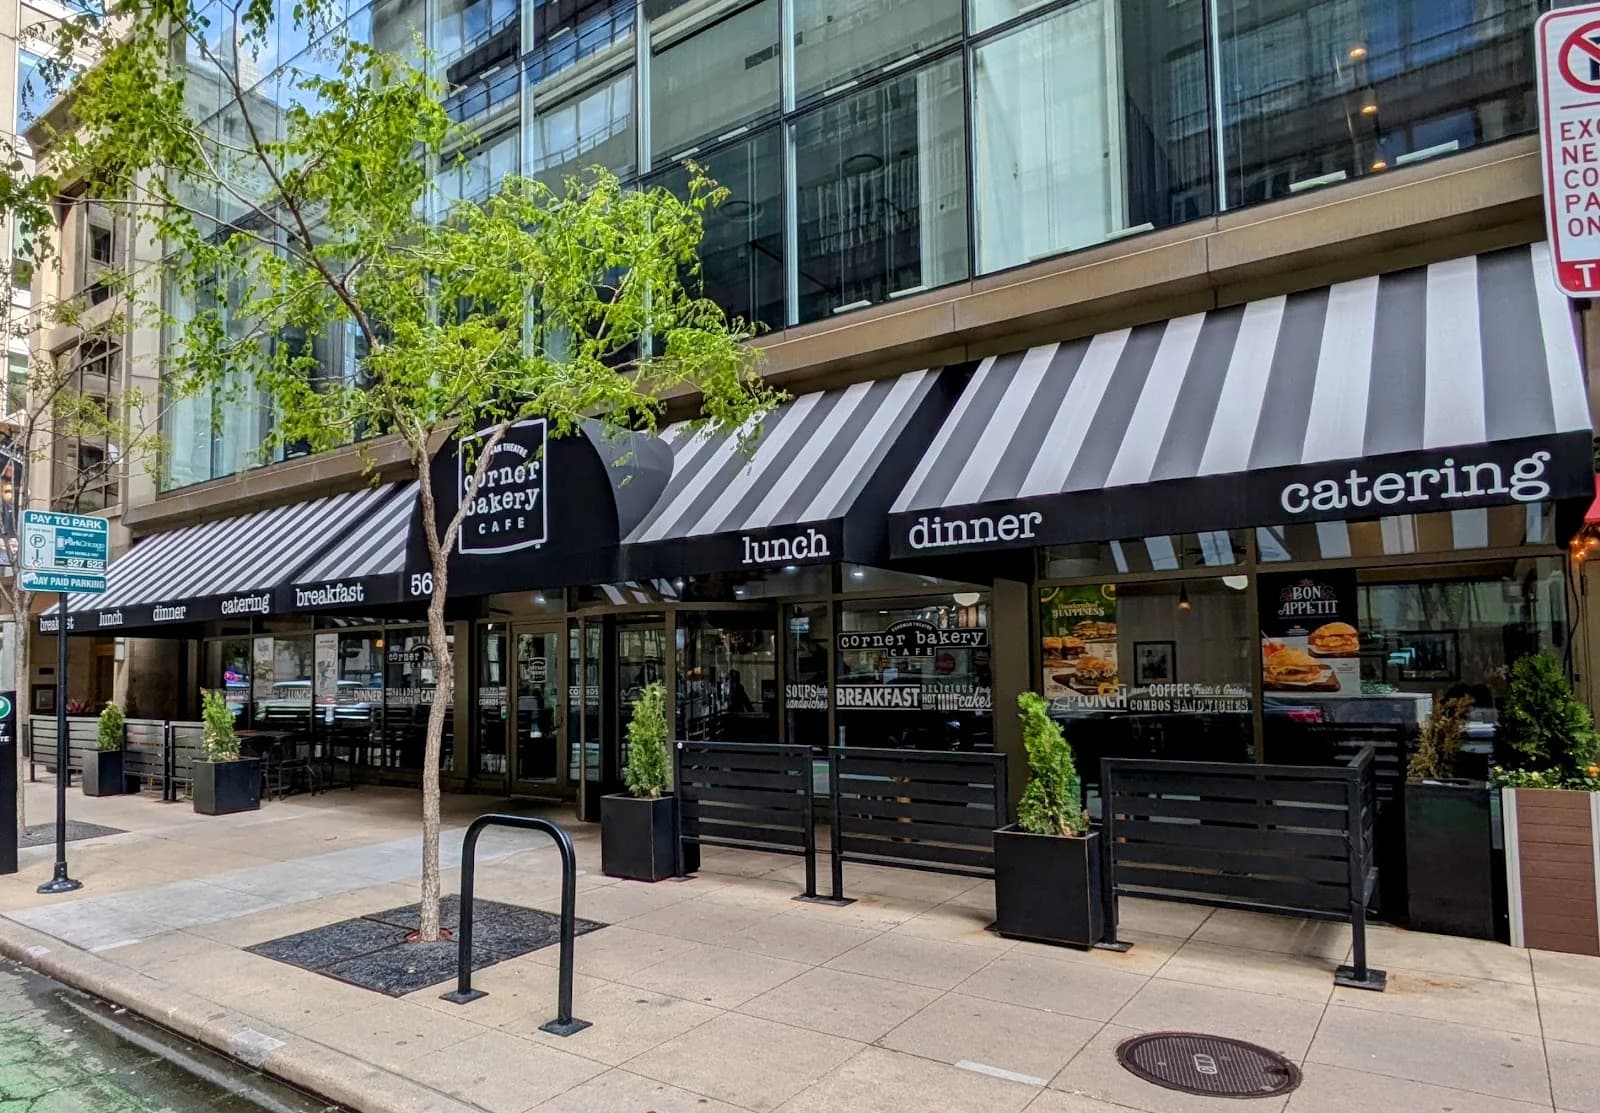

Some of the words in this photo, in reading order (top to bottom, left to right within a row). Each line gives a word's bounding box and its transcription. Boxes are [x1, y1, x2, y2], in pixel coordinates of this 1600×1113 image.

[1560, 118, 1600, 142] EX
[1561, 143, 1598, 166] NE
[1564, 167, 1599, 190] CO
[1565, 191, 1600, 214] PA
[1567, 215, 1600, 238] ON
[1574, 262, 1597, 289] T
[502, 442, 529, 458] THEATRE
[1281, 451, 1551, 513] catering
[30, 513, 52, 524] PAY
[53, 516, 70, 526] TO
[72, 518, 102, 530] PARK
[478, 516, 525, 534] CAFE
[909, 511, 1043, 549] dinner
[742, 529, 830, 564] lunch
[50, 576, 69, 587] PAID
[71, 577, 105, 589] PARKING
[295, 582, 364, 606] breakfast
[1292, 586, 1321, 600] BON
[221, 593, 270, 615] catering
[1052, 607, 1105, 618] HAPPINESS
[99, 610, 123, 626] lunch
[153, 605, 187, 621] dinner
[39, 616, 75, 631] breakst
[841, 633, 906, 648] corner
[915, 630, 985, 647] bakery
[890, 647, 933, 656] CAFE
[288, 688, 312, 703] LUNCH
[569, 688, 599, 696] COBOS
[786, 684, 817, 699] SOUPS
[921, 682, 974, 694] DELICIOUS
[1149, 683, 1191, 698] COFFEE
[353, 689, 383, 705] DINNER
[836, 687, 921, 708] BREAKFAST
[921, 693, 937, 704] HOT
[959, 687, 993, 708] cakes
[1130, 699, 1172, 712] COMBOS
